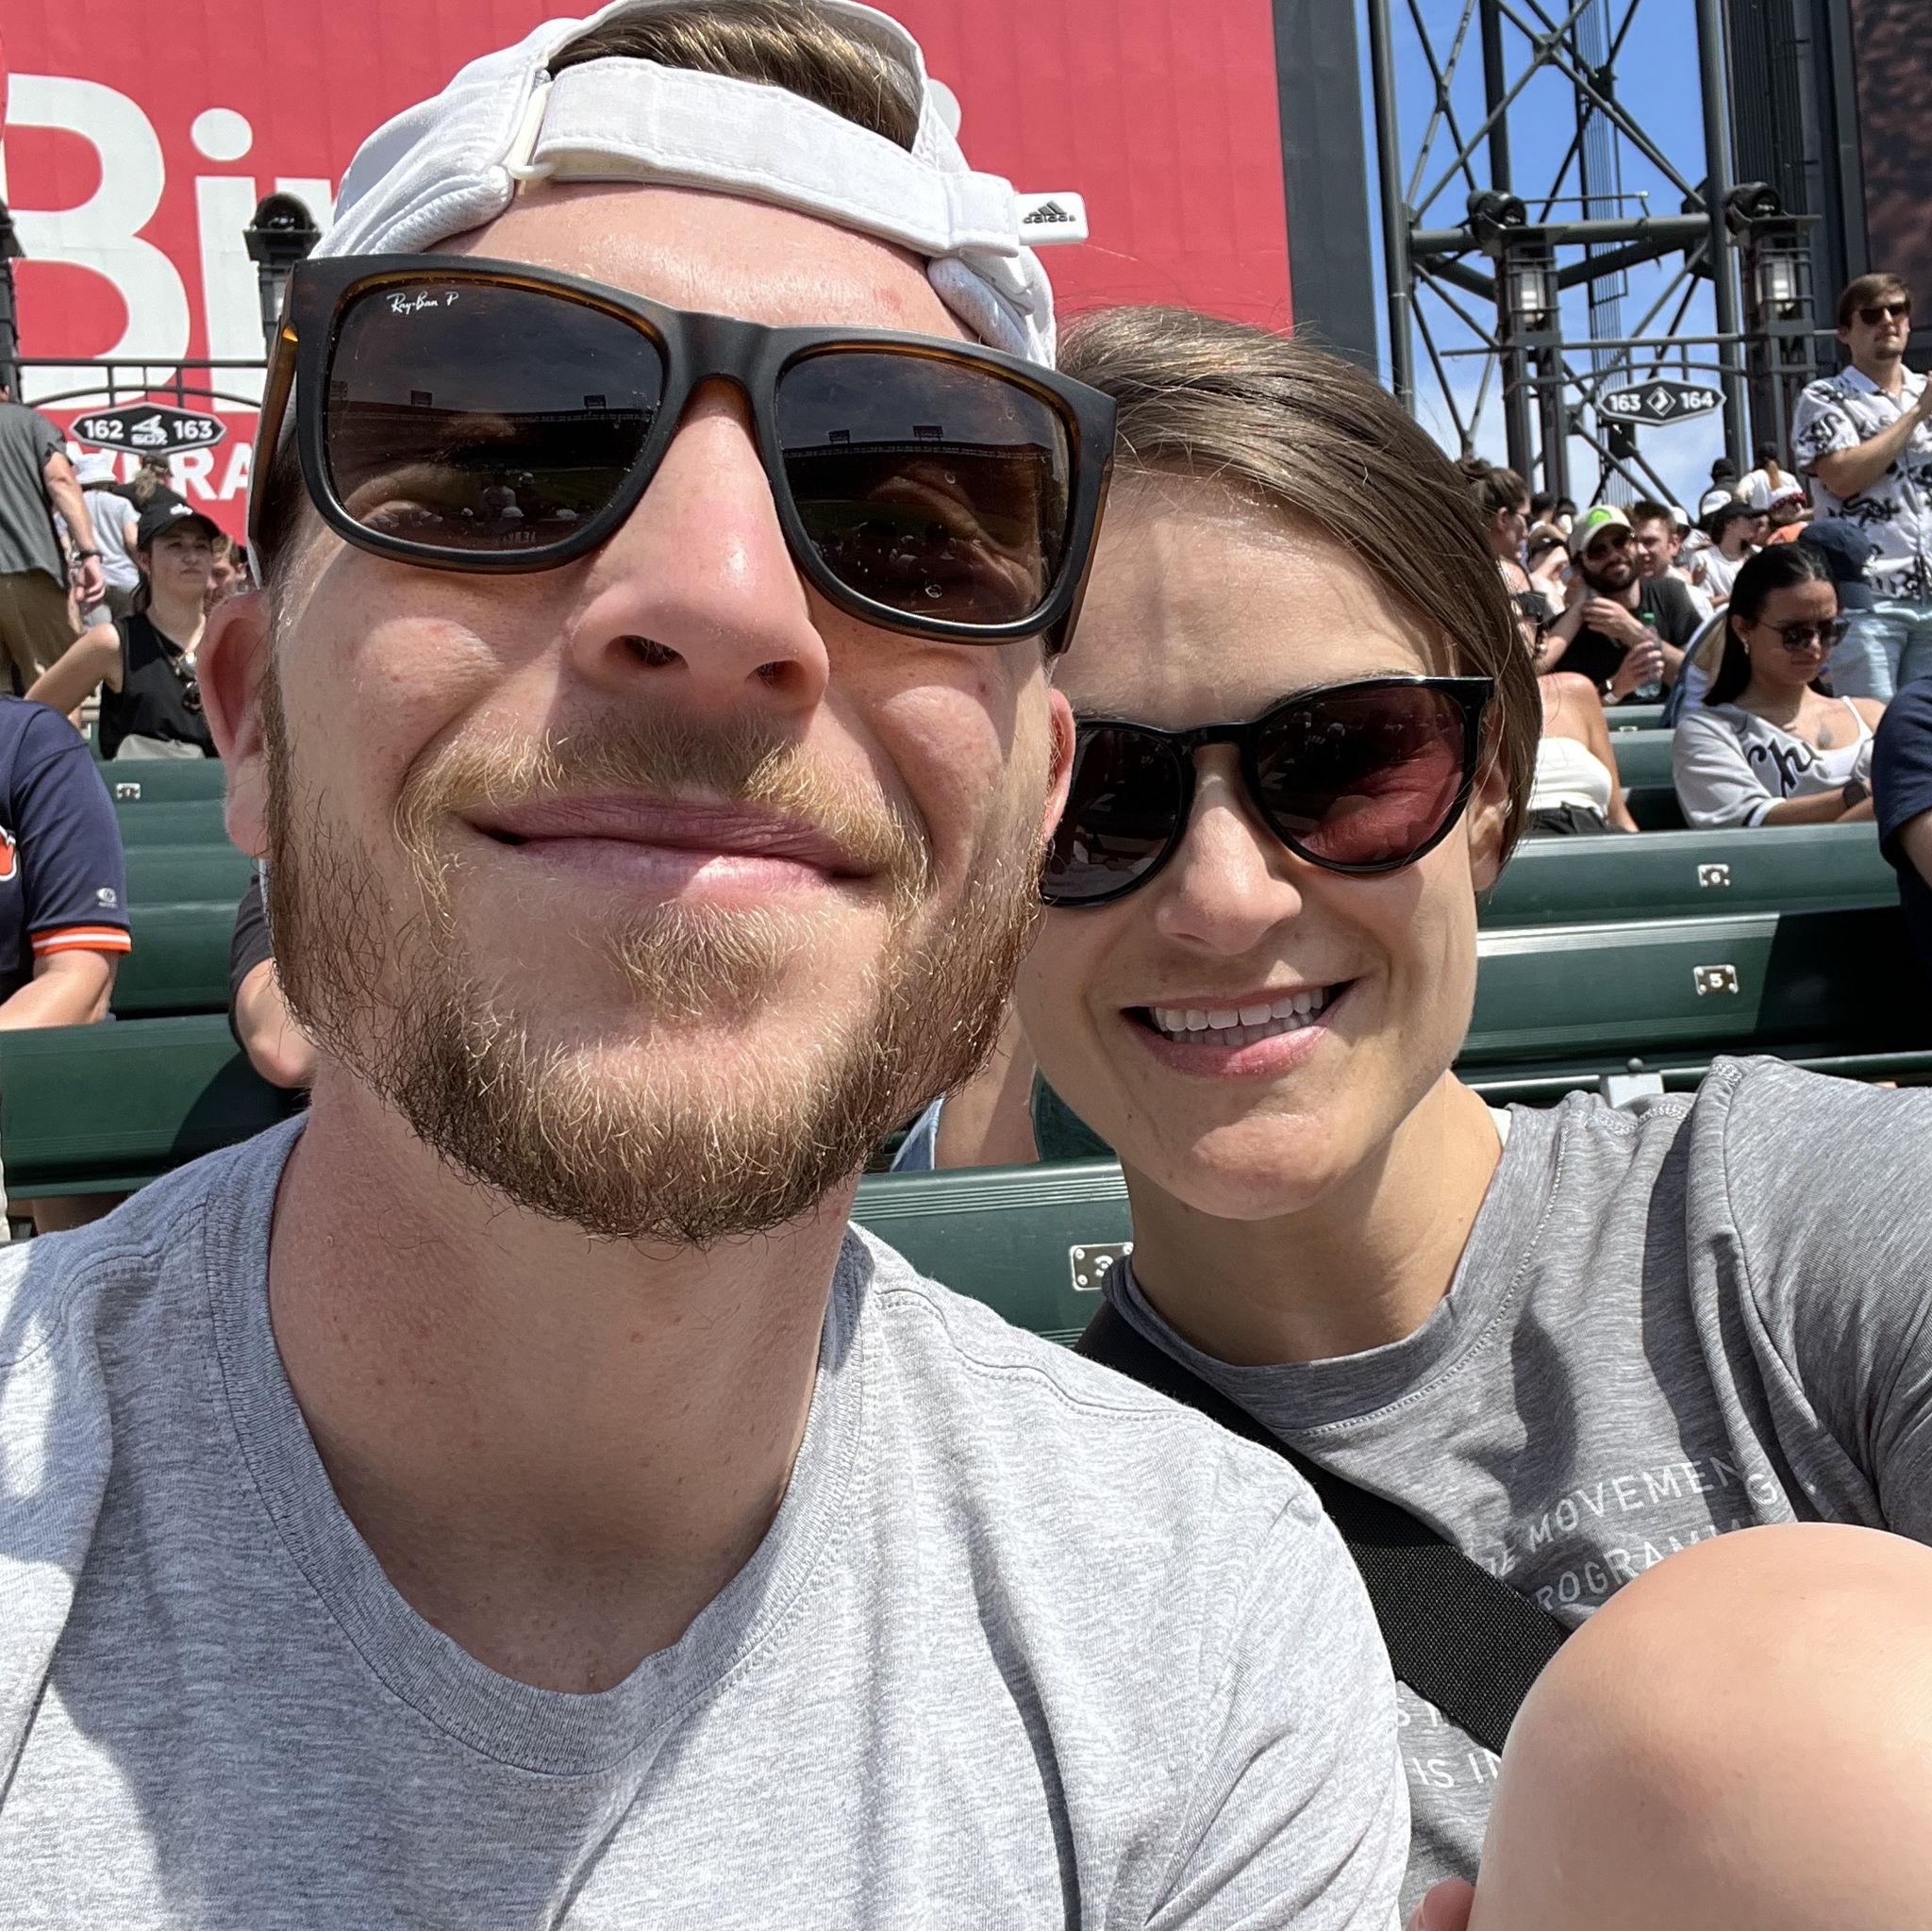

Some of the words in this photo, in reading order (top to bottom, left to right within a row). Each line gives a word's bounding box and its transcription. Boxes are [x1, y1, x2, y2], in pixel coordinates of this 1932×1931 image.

[386, 290, 439, 315] Ray-Ban
[445, 291, 459, 306] P
[1609, 394, 1641, 411] 163
[1680, 391, 1714, 409] 164
[83, 420, 125, 439] 162
[173, 421, 213, 440] 163
[1709, 973, 1724, 988] 5
[1529, 1452, 1740, 1553] MOVEMEN
